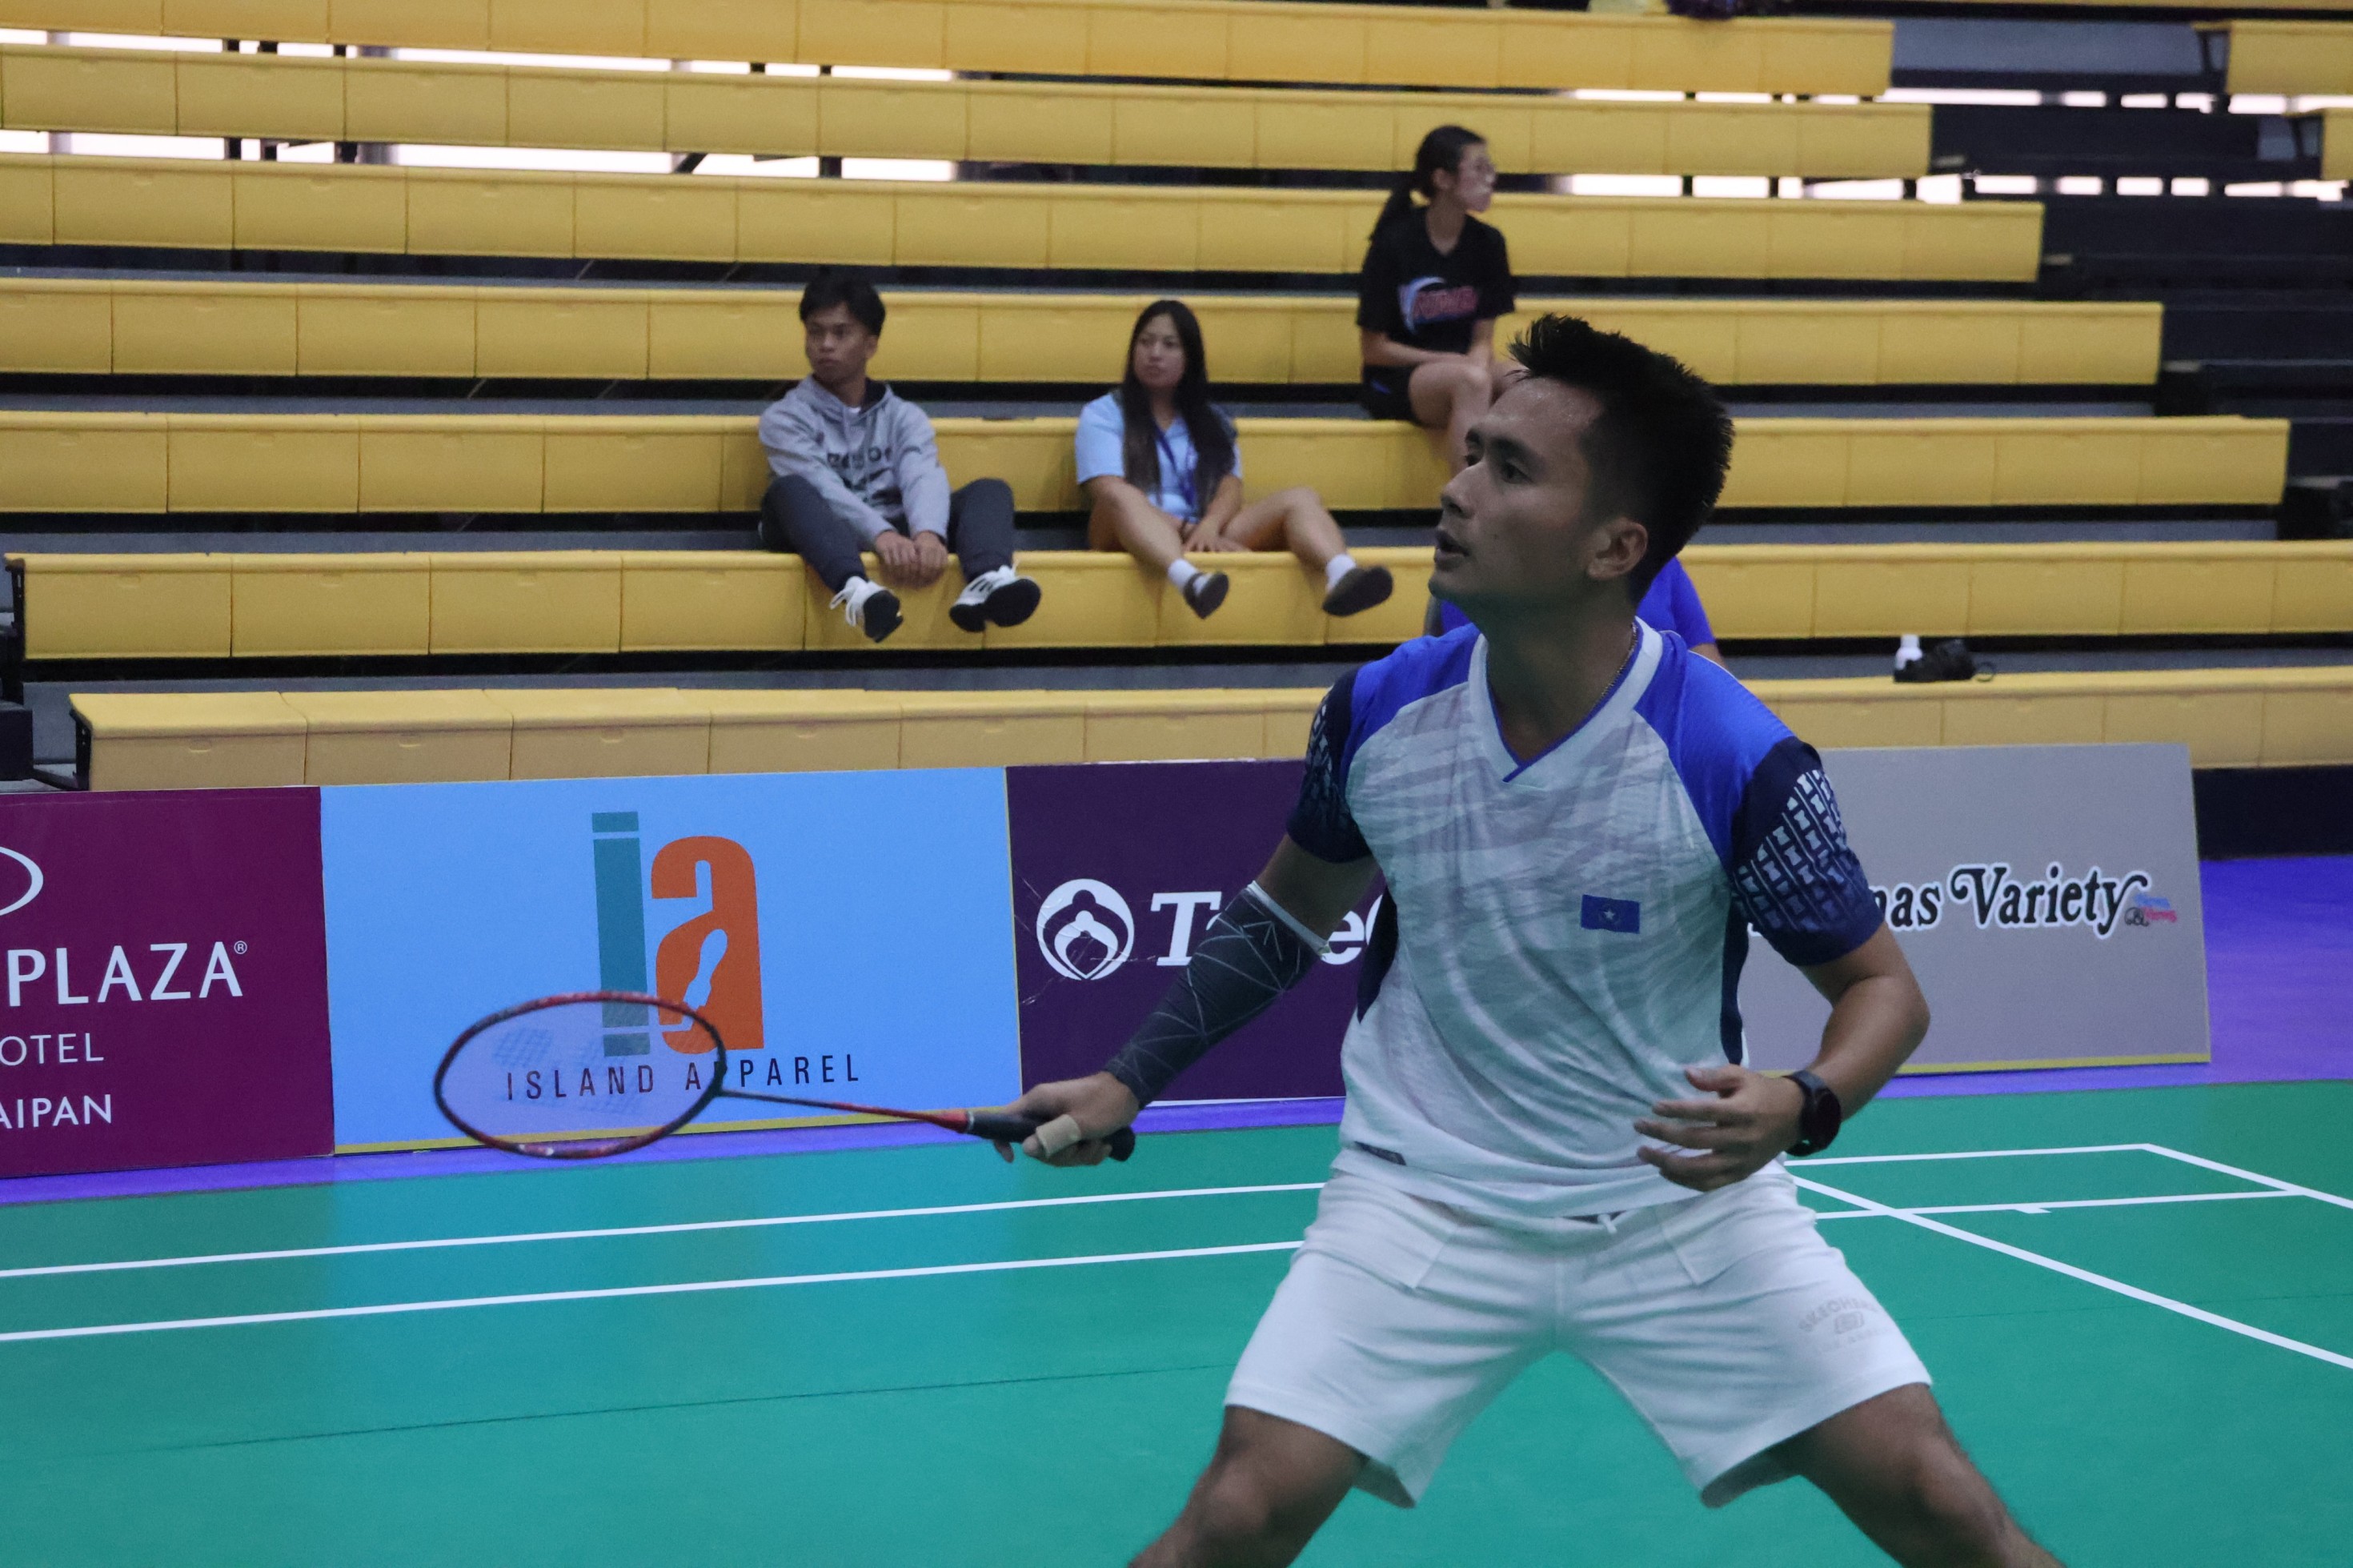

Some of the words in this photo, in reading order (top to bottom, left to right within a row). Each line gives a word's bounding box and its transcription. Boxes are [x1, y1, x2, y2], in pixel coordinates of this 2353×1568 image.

[1950, 864, 2149, 936] Variety
[507, 1064, 654, 1101] ISLAND
[684, 1053, 859, 1091] APAREL
